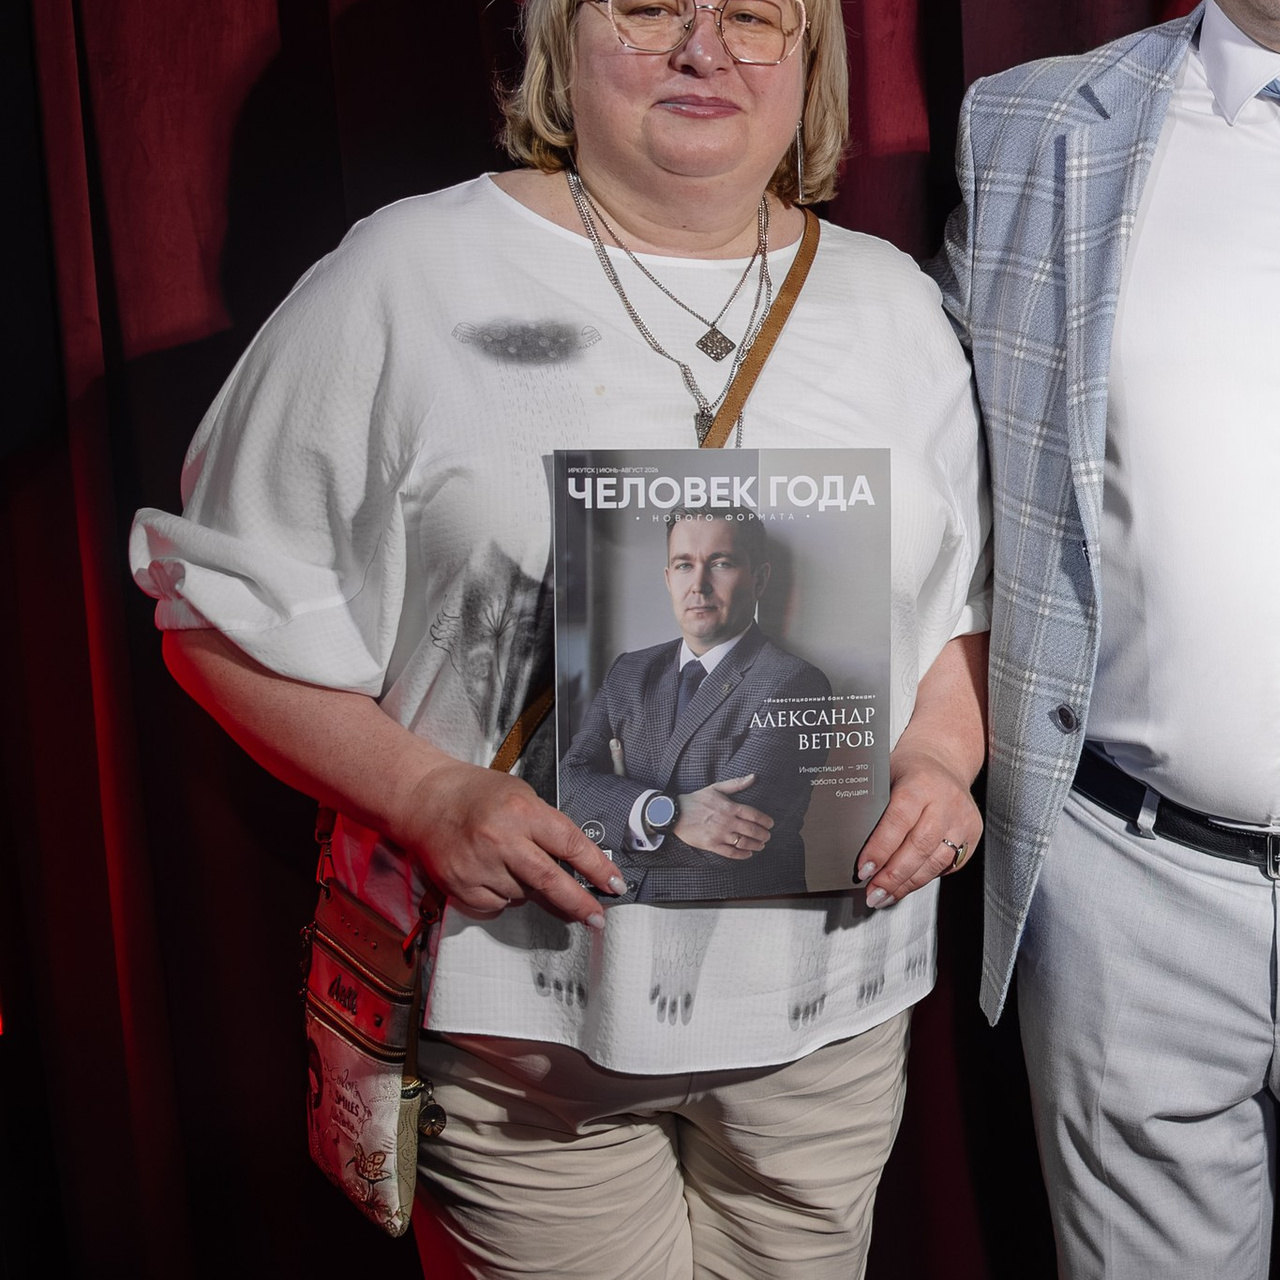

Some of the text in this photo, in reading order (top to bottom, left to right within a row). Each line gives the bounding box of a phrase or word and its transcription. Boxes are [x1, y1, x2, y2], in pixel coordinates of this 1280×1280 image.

[568, 475, 876, 512] ЧЕЛОВЕК ГОДА
[652, 513, 795, 522] НОВОГО ФОРМАТА
[749, 707, 876, 729] АЛЕКСАНДР
[798, 730, 875, 750] ВЕТРОВ
[799, 766, 844, 774] Инвестиции
[811, 778, 837, 786] забота
[835, 789, 868, 797] будущем
[584, 828, 600, 838] 18+
